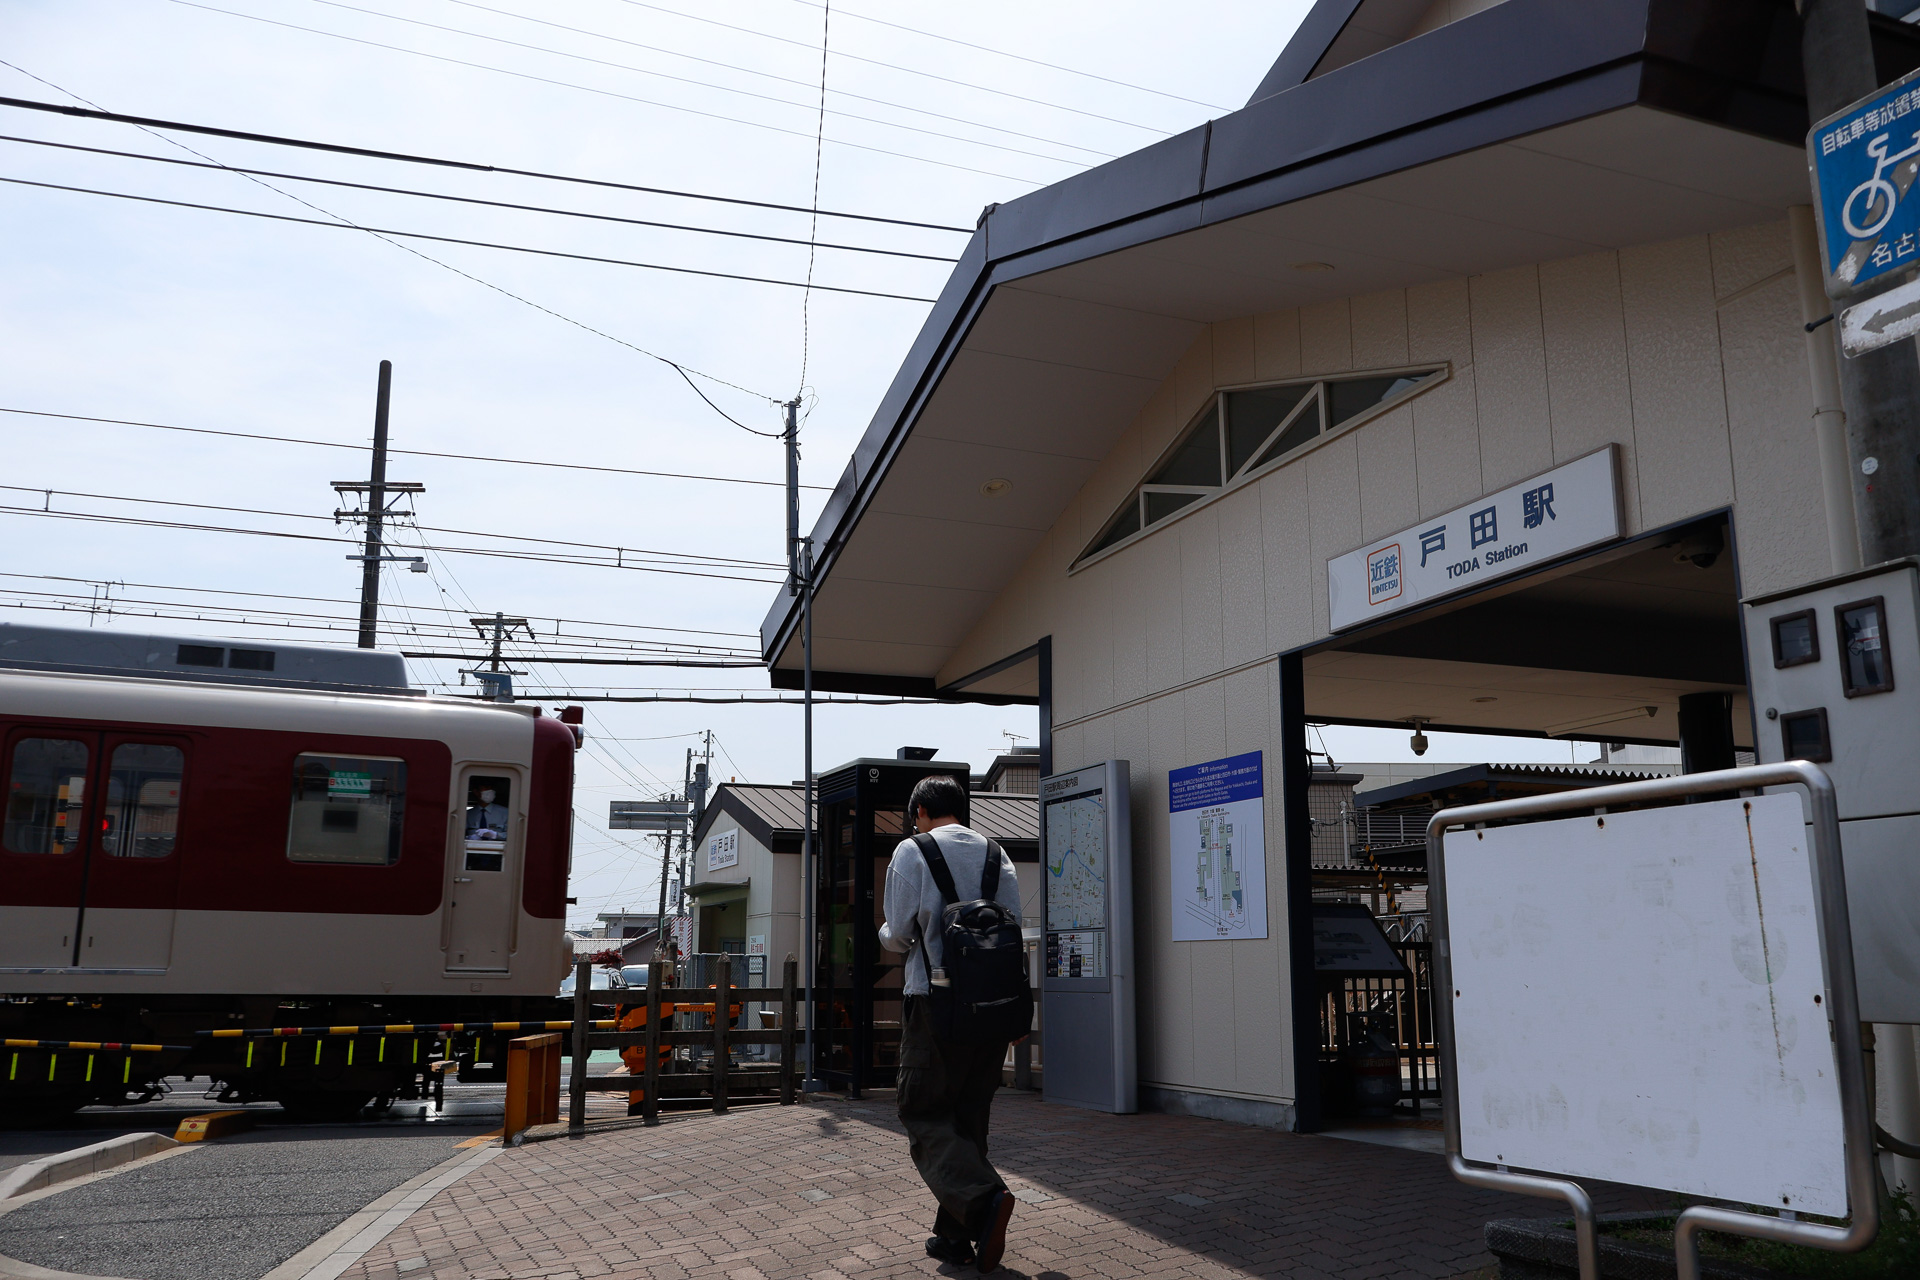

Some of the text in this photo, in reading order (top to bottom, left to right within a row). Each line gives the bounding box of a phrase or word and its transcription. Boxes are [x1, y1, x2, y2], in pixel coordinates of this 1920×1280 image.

[1871, 228, 1920, 268] 名古
[1418, 482, 1557, 569] 戸田駅
[1370, 553, 1399, 583] 近鉄
[1446, 541, 1529, 580] TODA Station
[1371, 578, 1399, 596] KINTETSU
